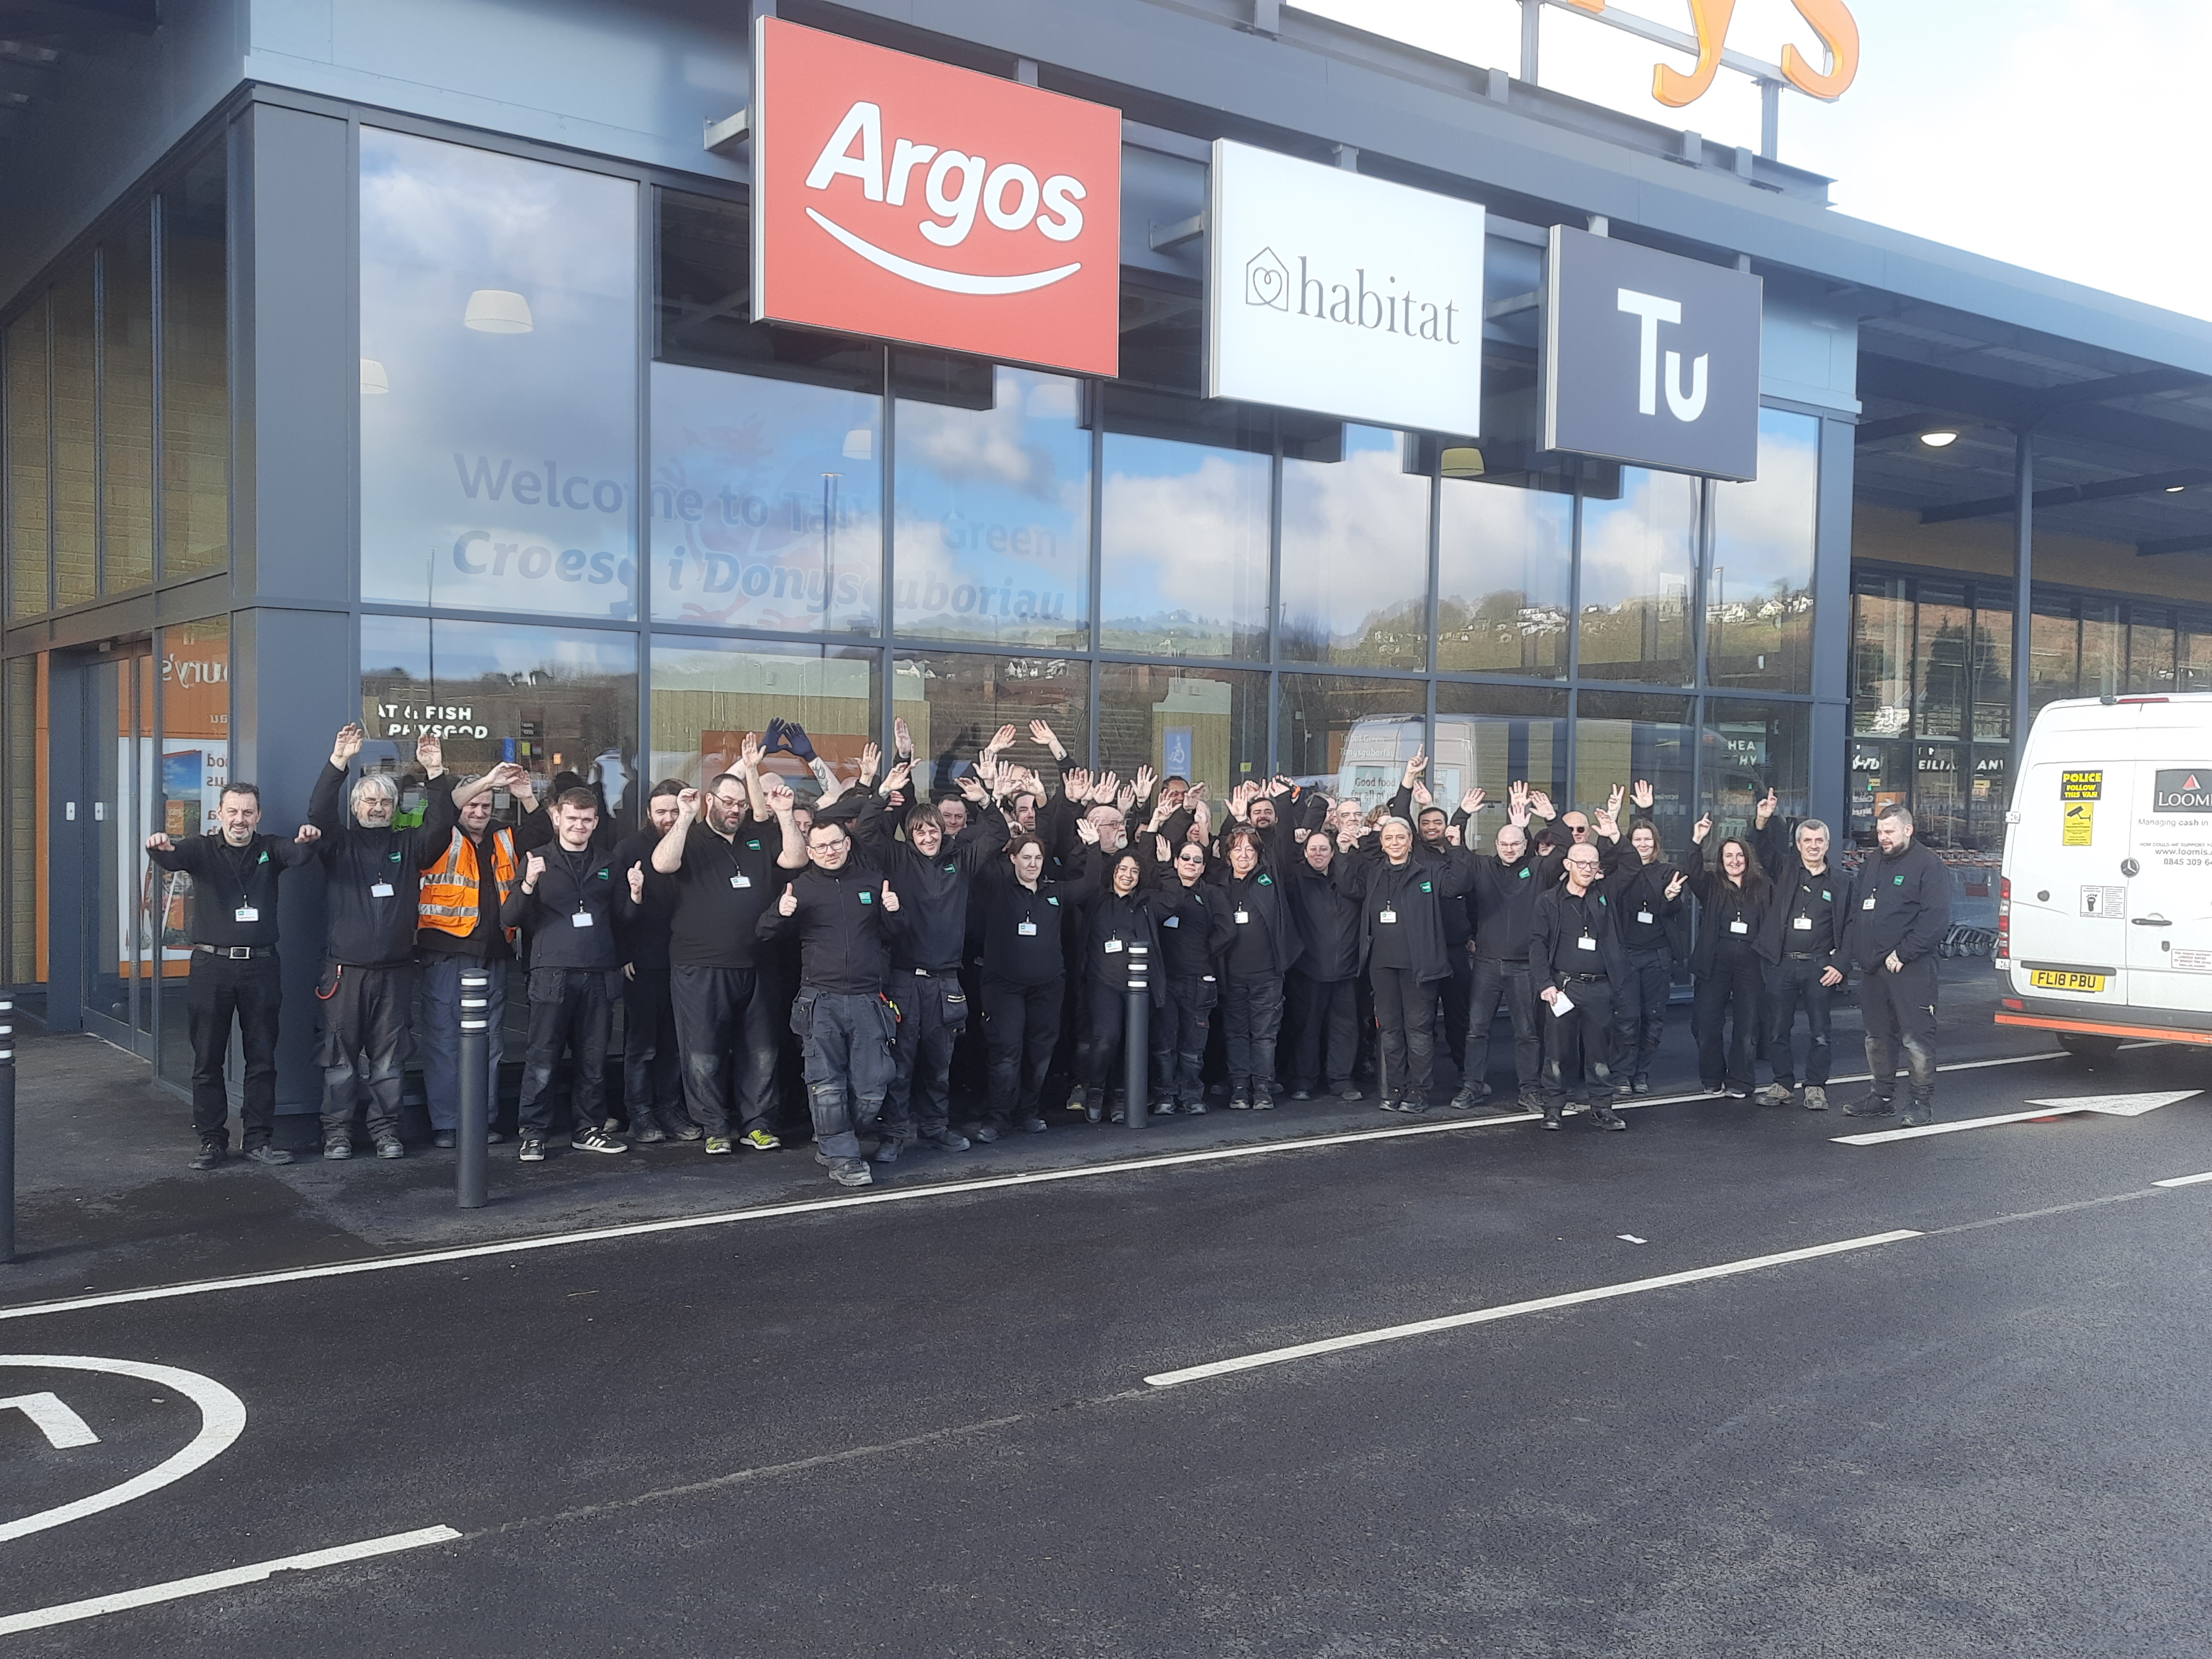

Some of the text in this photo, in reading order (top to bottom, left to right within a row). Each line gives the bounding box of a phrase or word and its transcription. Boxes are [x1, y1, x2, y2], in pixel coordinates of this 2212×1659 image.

[806, 101, 1087, 246] Argos
[1297, 255, 1460, 345] habitat
[1617, 287, 1709, 422] Tu
[718, 484, 768, 528] to
[941, 509, 1057, 559] Green
[667, 545, 686, 591] i
[425, 706, 473, 721] FISH
[1355, 777, 1396, 787] Good food
[2062, 773, 2101, 783] POLICE
[2138, 818, 2176, 827] Managing
[2037, 972, 2096, 988] FL18 PBU
